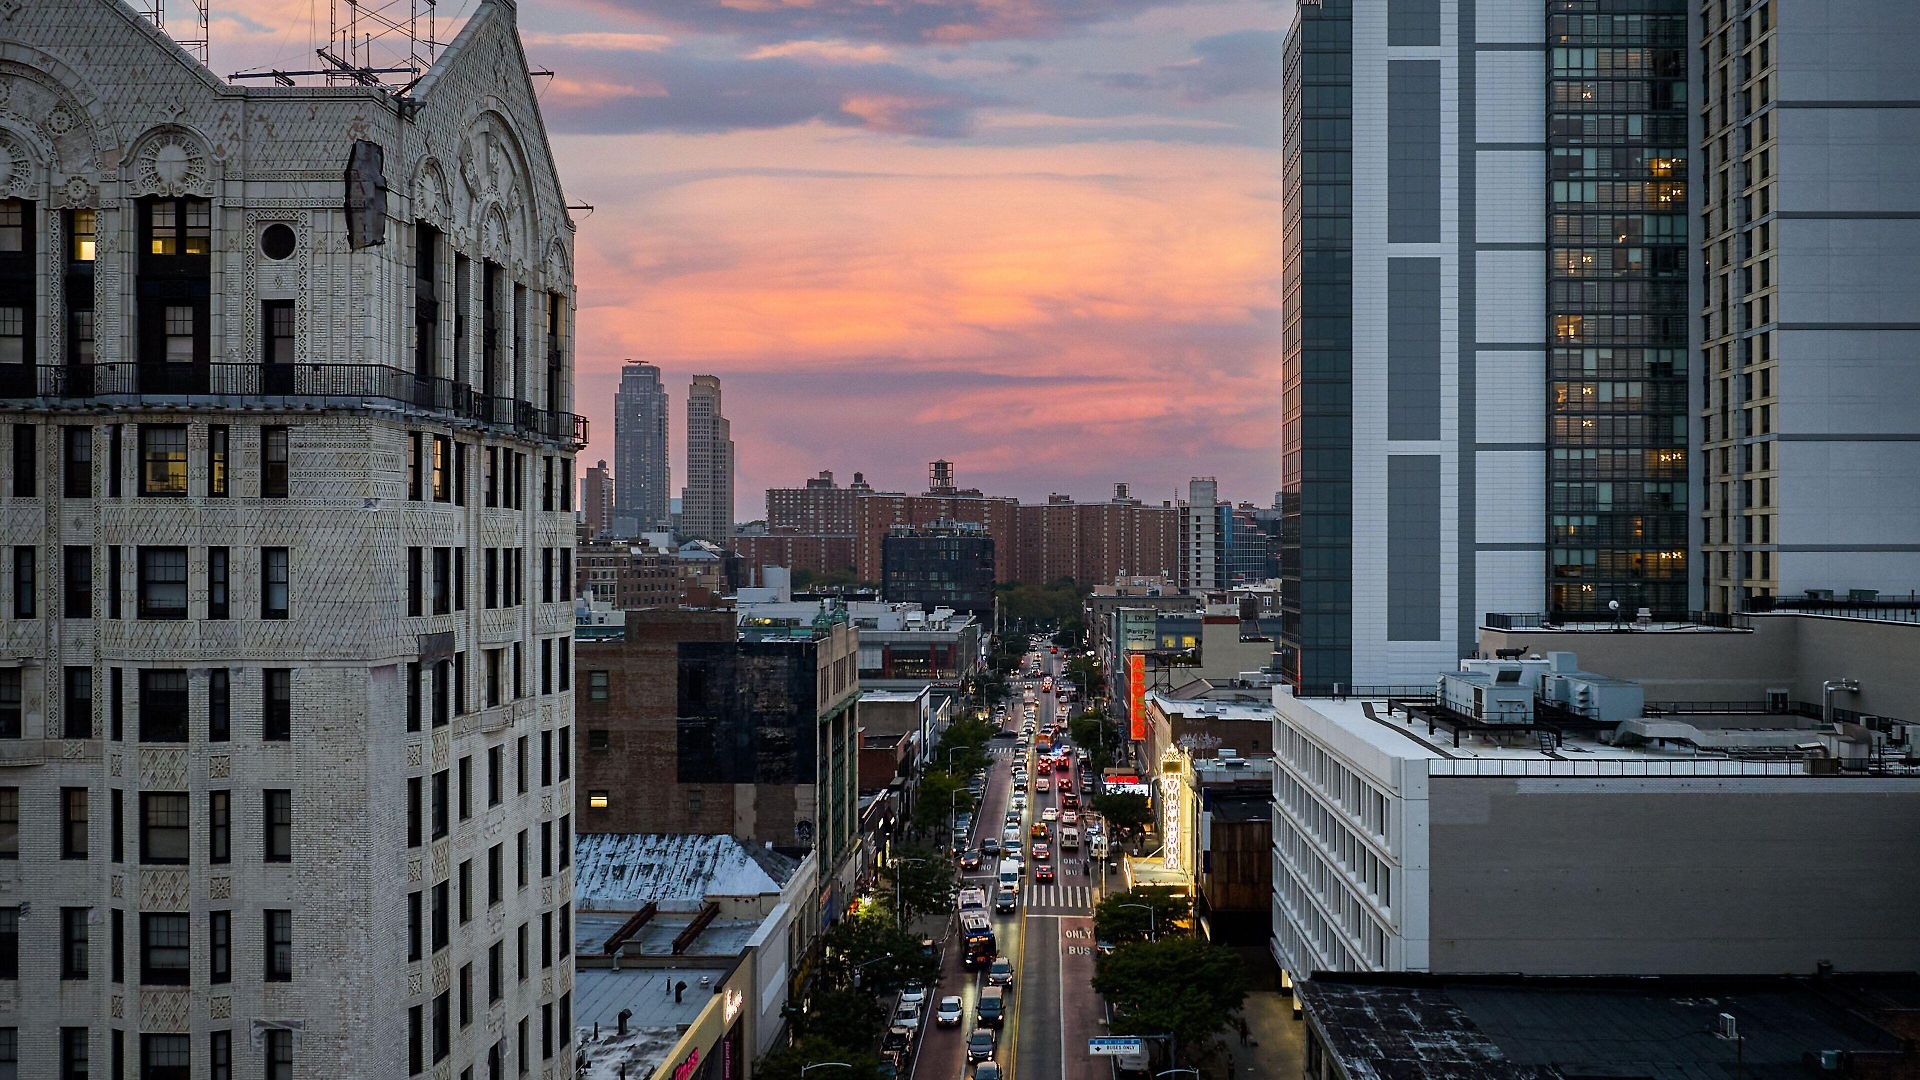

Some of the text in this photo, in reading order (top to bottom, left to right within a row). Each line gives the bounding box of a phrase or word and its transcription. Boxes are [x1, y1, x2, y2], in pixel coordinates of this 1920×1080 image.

[1132, 659, 1145, 737] APOLLO
[1066, 930, 1092, 939] ONLY
[1068, 946, 1091, 955] BUS
